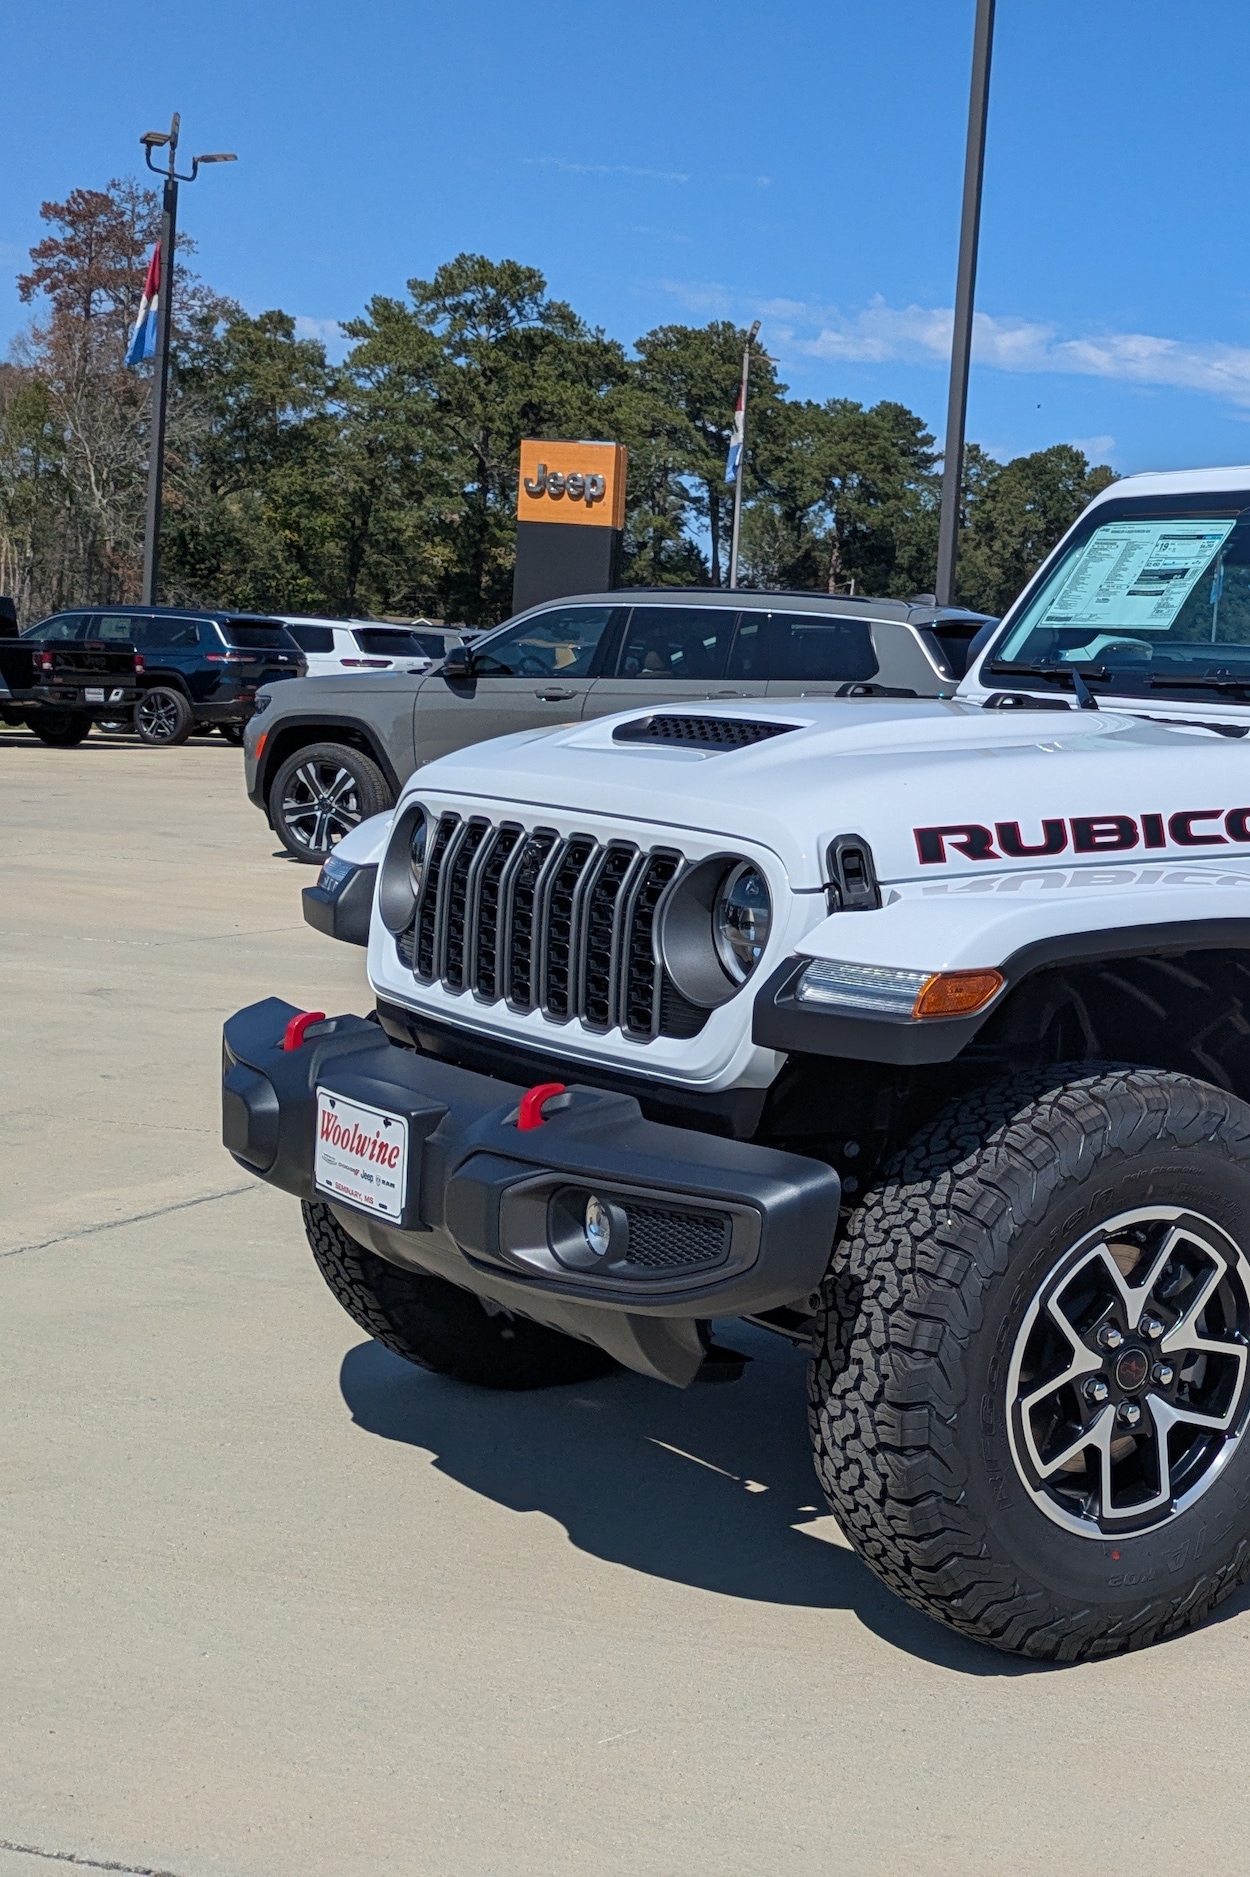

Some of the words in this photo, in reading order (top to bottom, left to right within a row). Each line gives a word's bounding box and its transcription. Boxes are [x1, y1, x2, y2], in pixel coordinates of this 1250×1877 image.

[523, 463, 606, 505] Jeep
[320, 1109, 400, 1169] Woolwine
[360, 1169, 374, 1184] Jeep
[381, 1179, 396, 1189] RAM
[335, 1181, 363, 1201] SEMINARY,
[364, 1194, 374, 1205] MS
